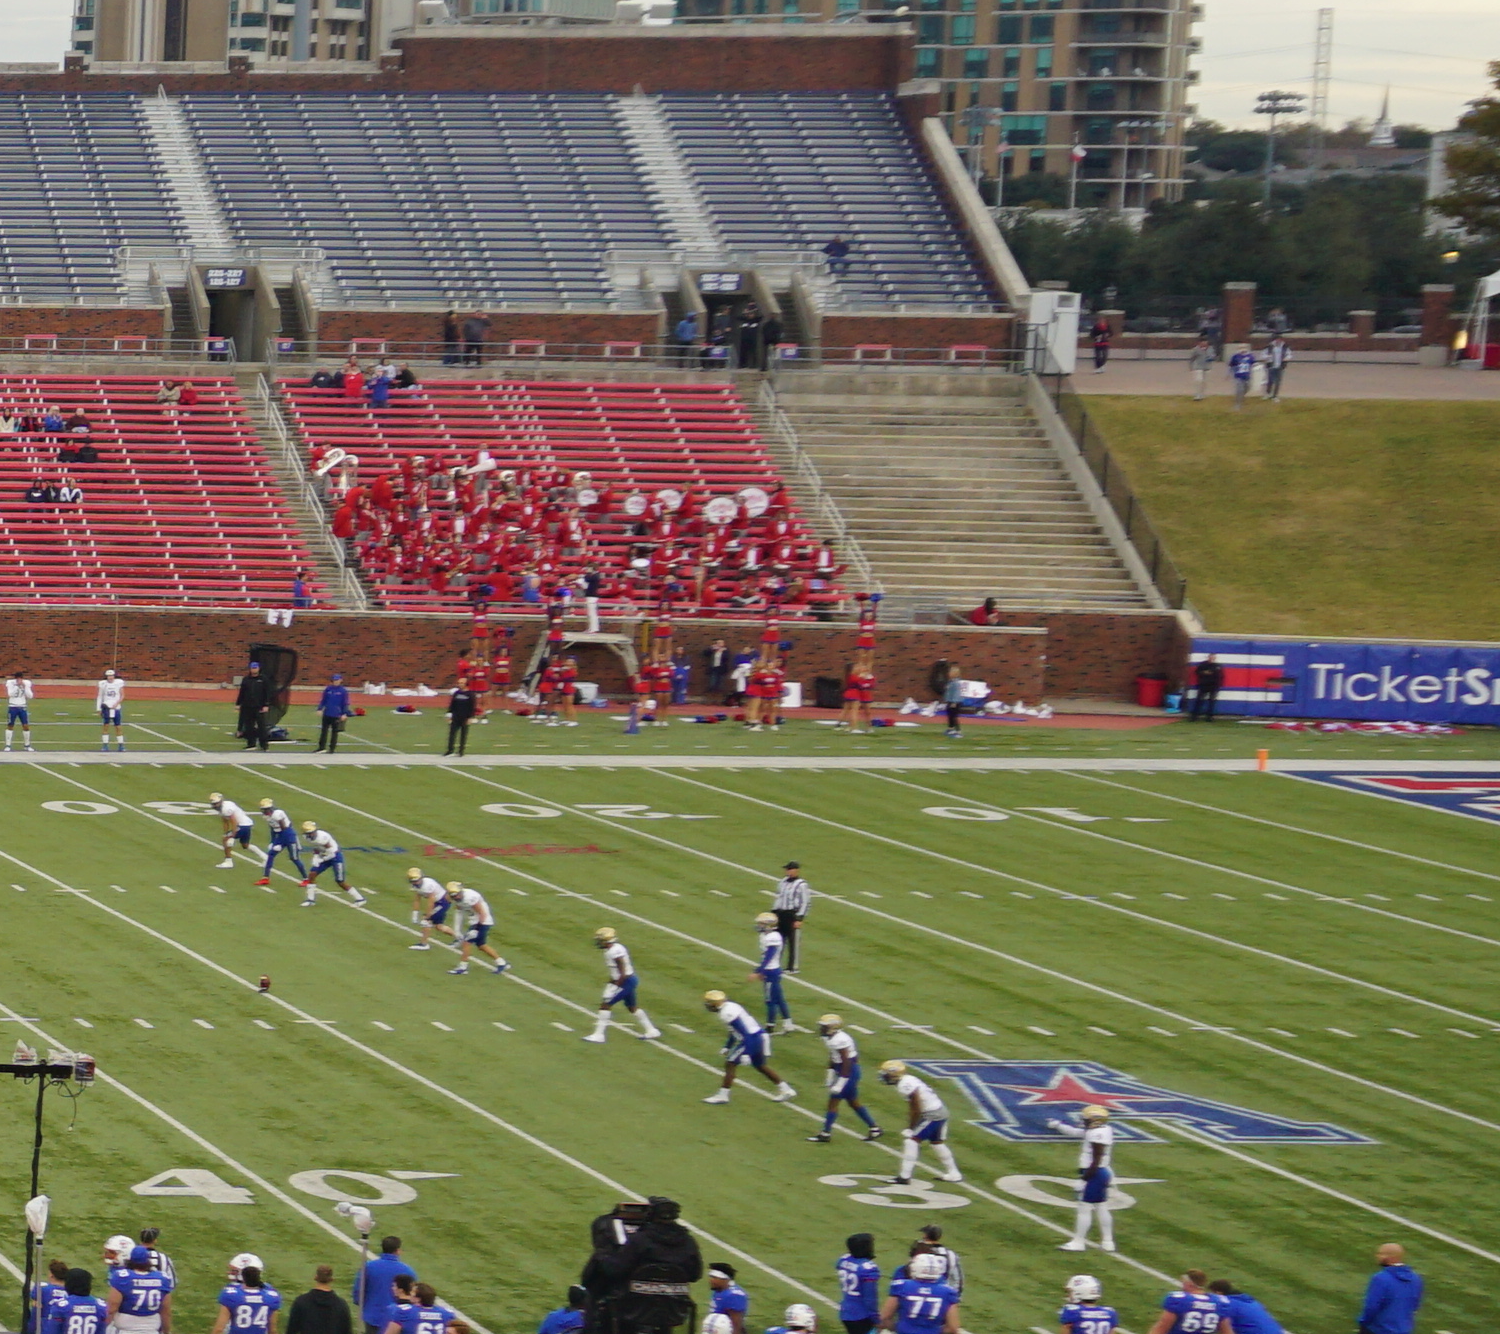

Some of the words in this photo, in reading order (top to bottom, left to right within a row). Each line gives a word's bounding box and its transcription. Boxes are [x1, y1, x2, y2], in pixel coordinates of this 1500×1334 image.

[1308, 662, 1500, 706] TicketS
[130, 1168, 419, 1206] 40
[131, 1287, 161, 1312] 70
[907, 1296, 943, 1319] 77
[236, 1304, 268, 1328] 84
